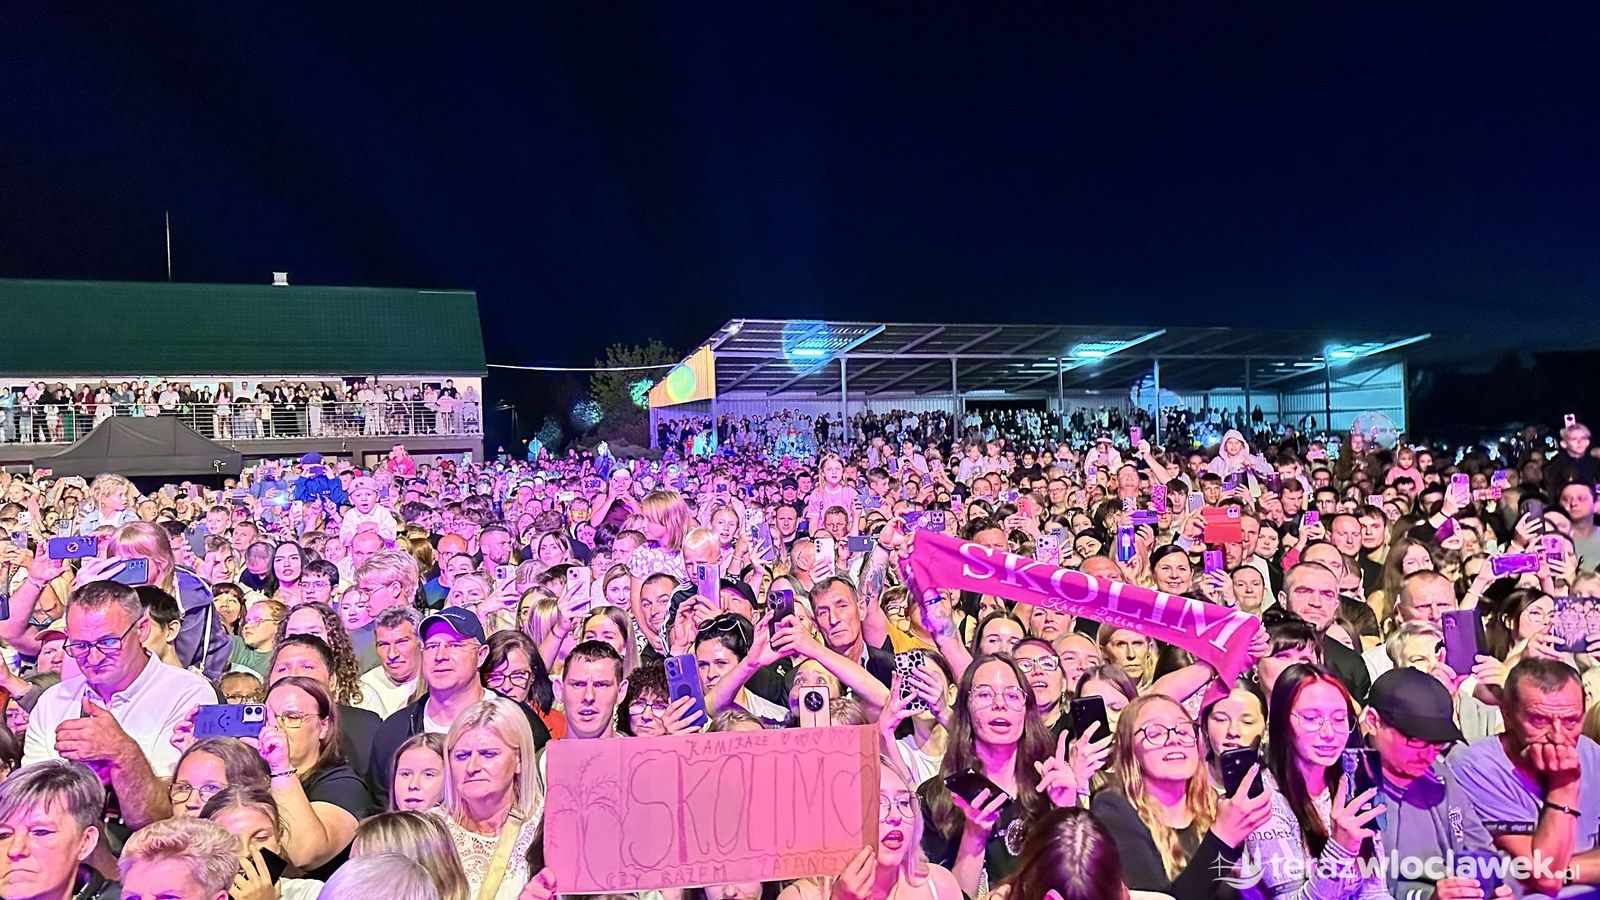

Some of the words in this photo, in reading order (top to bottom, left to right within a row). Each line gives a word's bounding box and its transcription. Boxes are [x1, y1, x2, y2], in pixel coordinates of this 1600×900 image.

[959, 543, 1260, 652] SKOLIM
[685, 735, 769, 760] KAMIKAZE
[629, 754, 830, 868] SKOLIM
[606, 871, 641, 889] CZY
[661, 864, 727, 886] RAZEM
